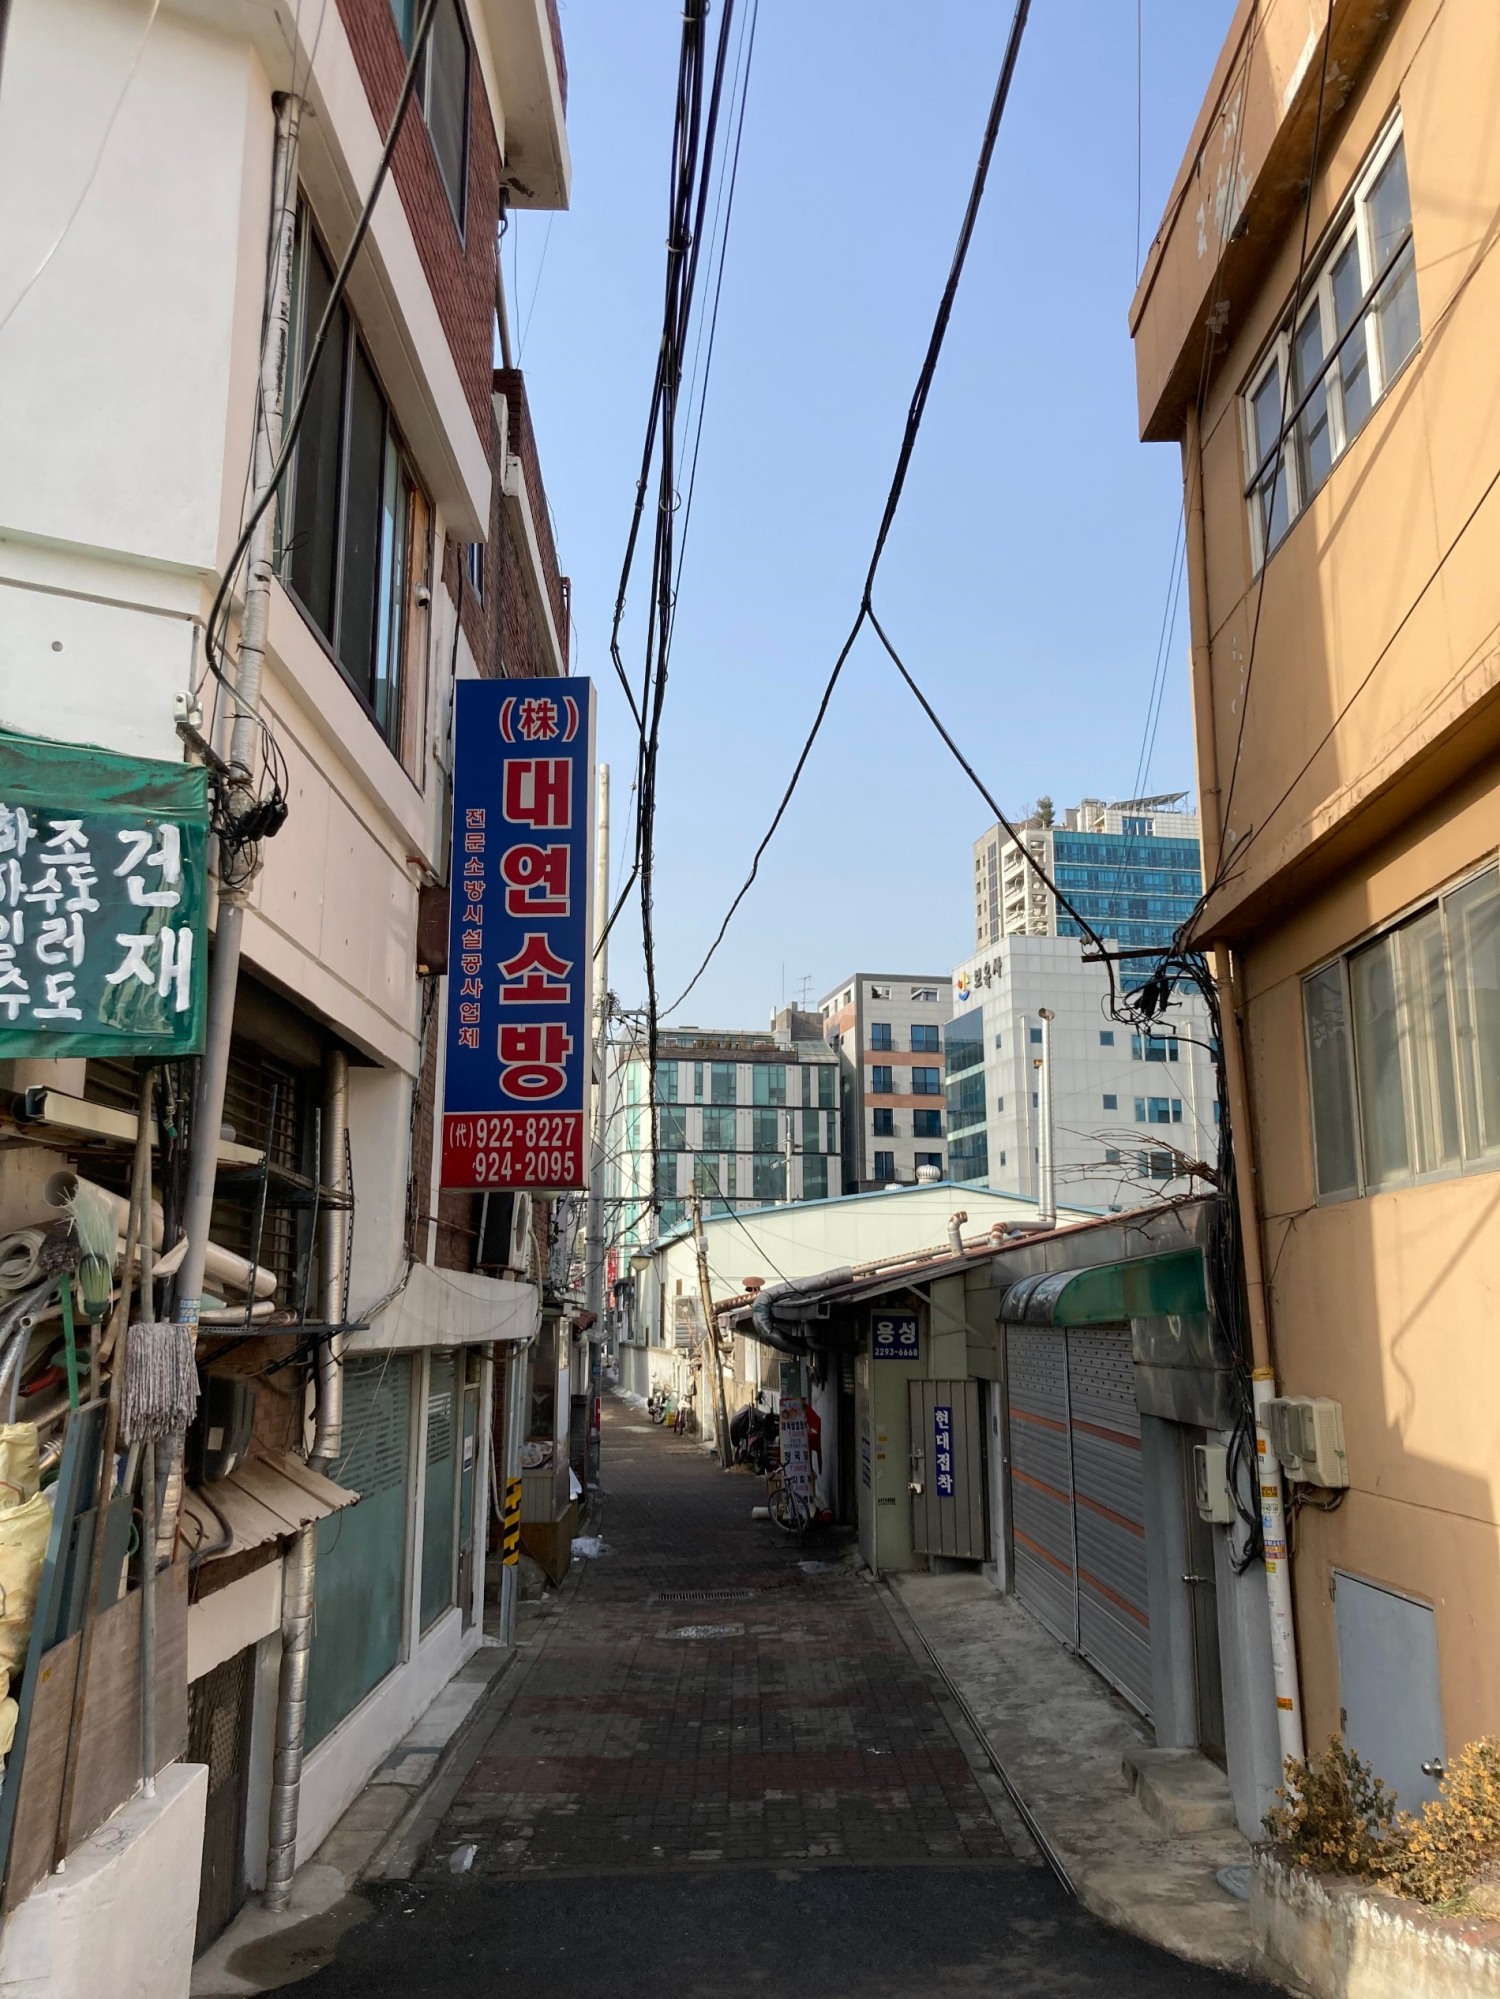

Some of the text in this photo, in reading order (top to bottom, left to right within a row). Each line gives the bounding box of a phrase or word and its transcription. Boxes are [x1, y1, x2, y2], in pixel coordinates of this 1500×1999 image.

[104, 823, 194, 1013] 건재
[458, 808, 486, 1049] 전문소방시설공사업체
[497, 757, 574, 1102] 대연소방
[476, 1117, 576, 1148] 922-8227
[474, 1151, 575, 1183] 924-2095
[874, 1347, 918, 1358] 2293-6668
[876, 1321, 916, 1345] 용성
[935, 1409, 954, 1494] 현대접착
